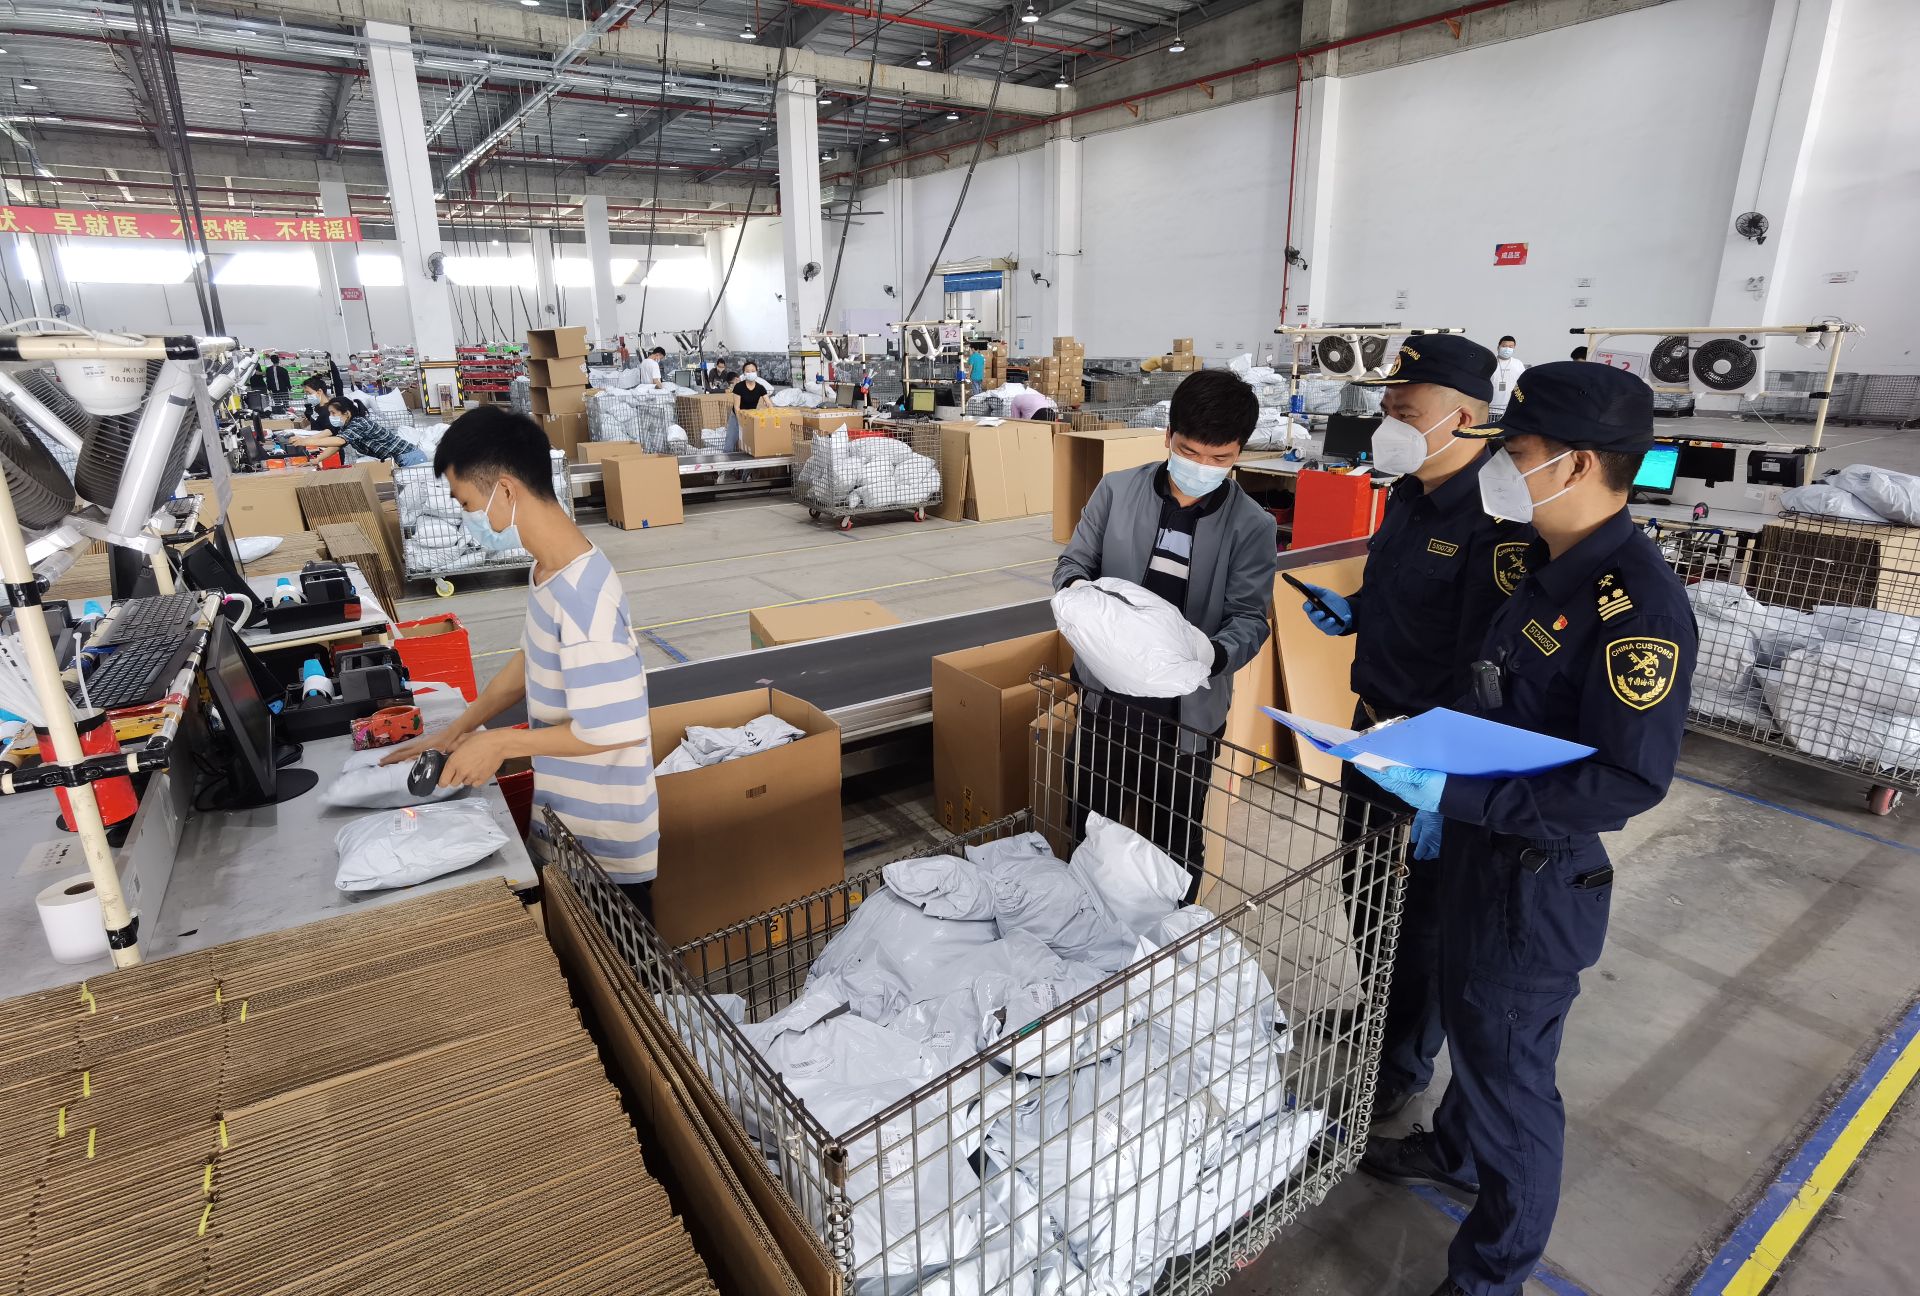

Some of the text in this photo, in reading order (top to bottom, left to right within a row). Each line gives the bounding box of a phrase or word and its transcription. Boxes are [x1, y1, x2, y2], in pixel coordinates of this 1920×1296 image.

[1528, 625, 1554, 651] 5134050
[1611, 642, 1674, 659] CHINA CUSTOMS
